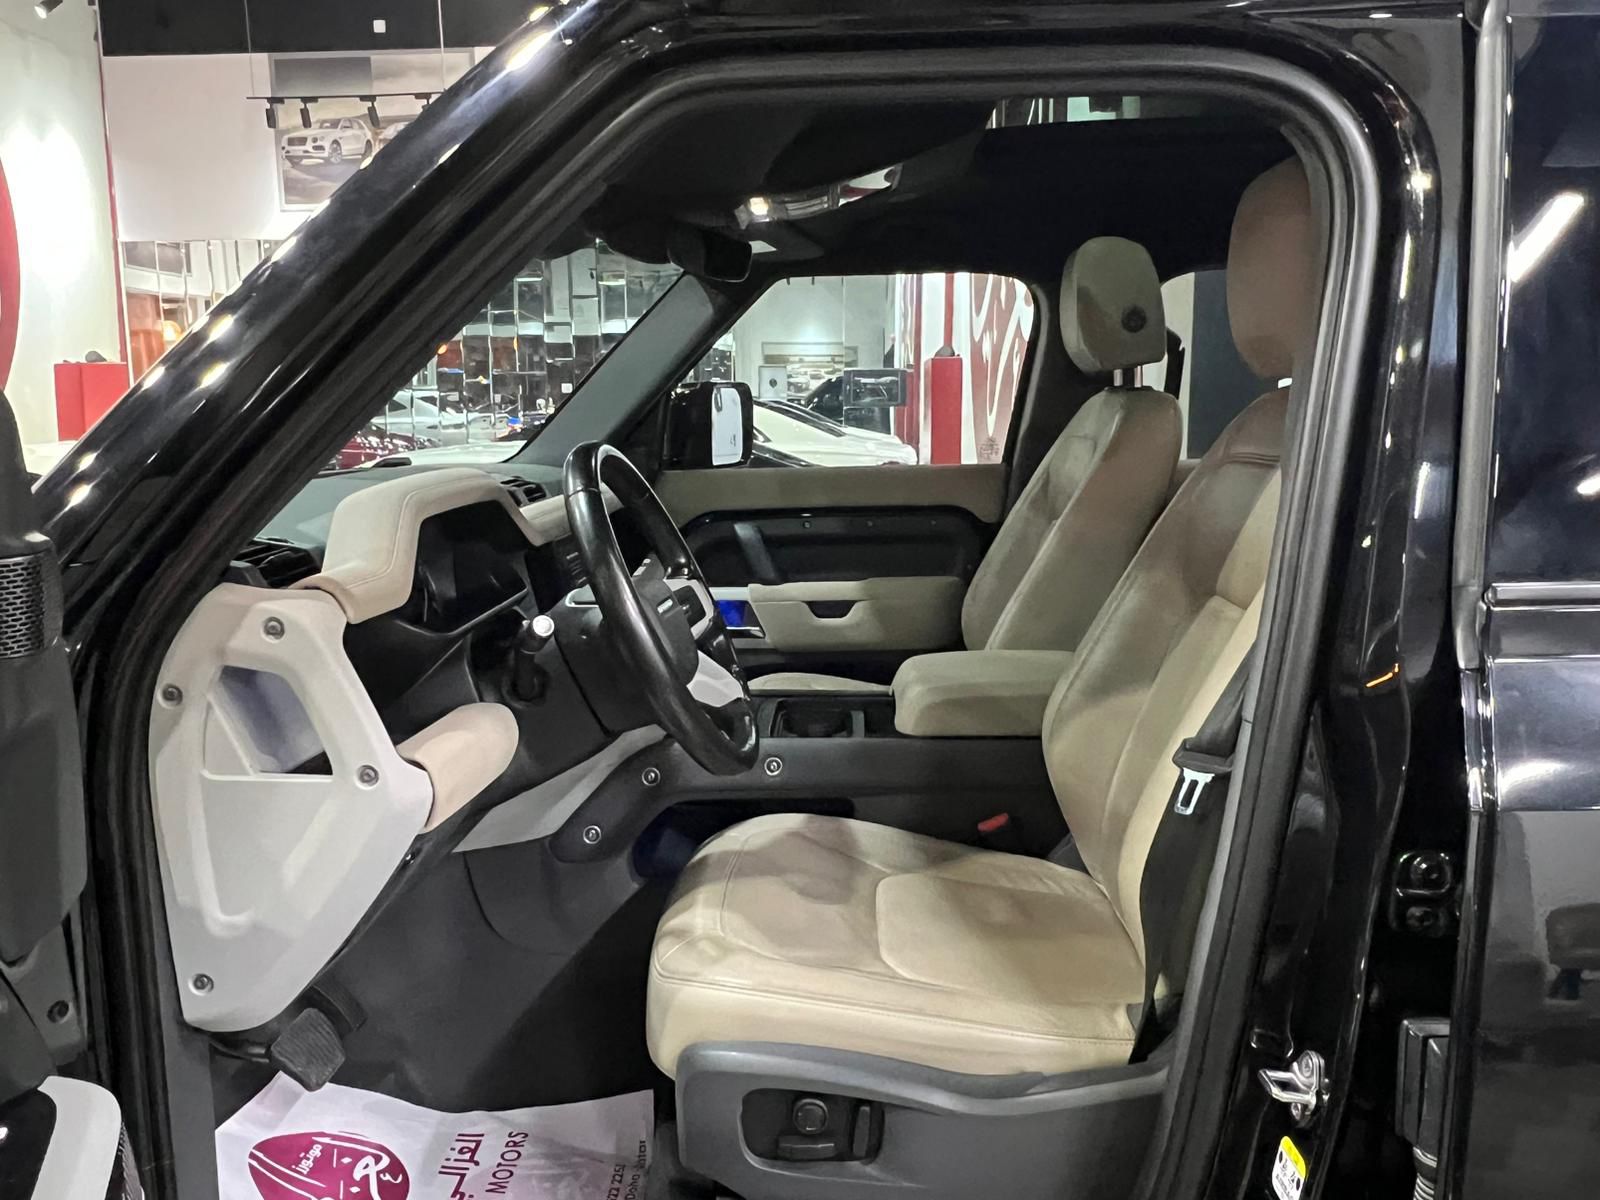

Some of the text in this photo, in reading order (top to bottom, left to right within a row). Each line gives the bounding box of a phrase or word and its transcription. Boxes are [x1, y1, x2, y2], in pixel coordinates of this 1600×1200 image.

[485, 1131, 529, 1194] MOTORS
[611, 1163, 626, 1184] 2251
[624, 1174, 641, 1200] Doha
